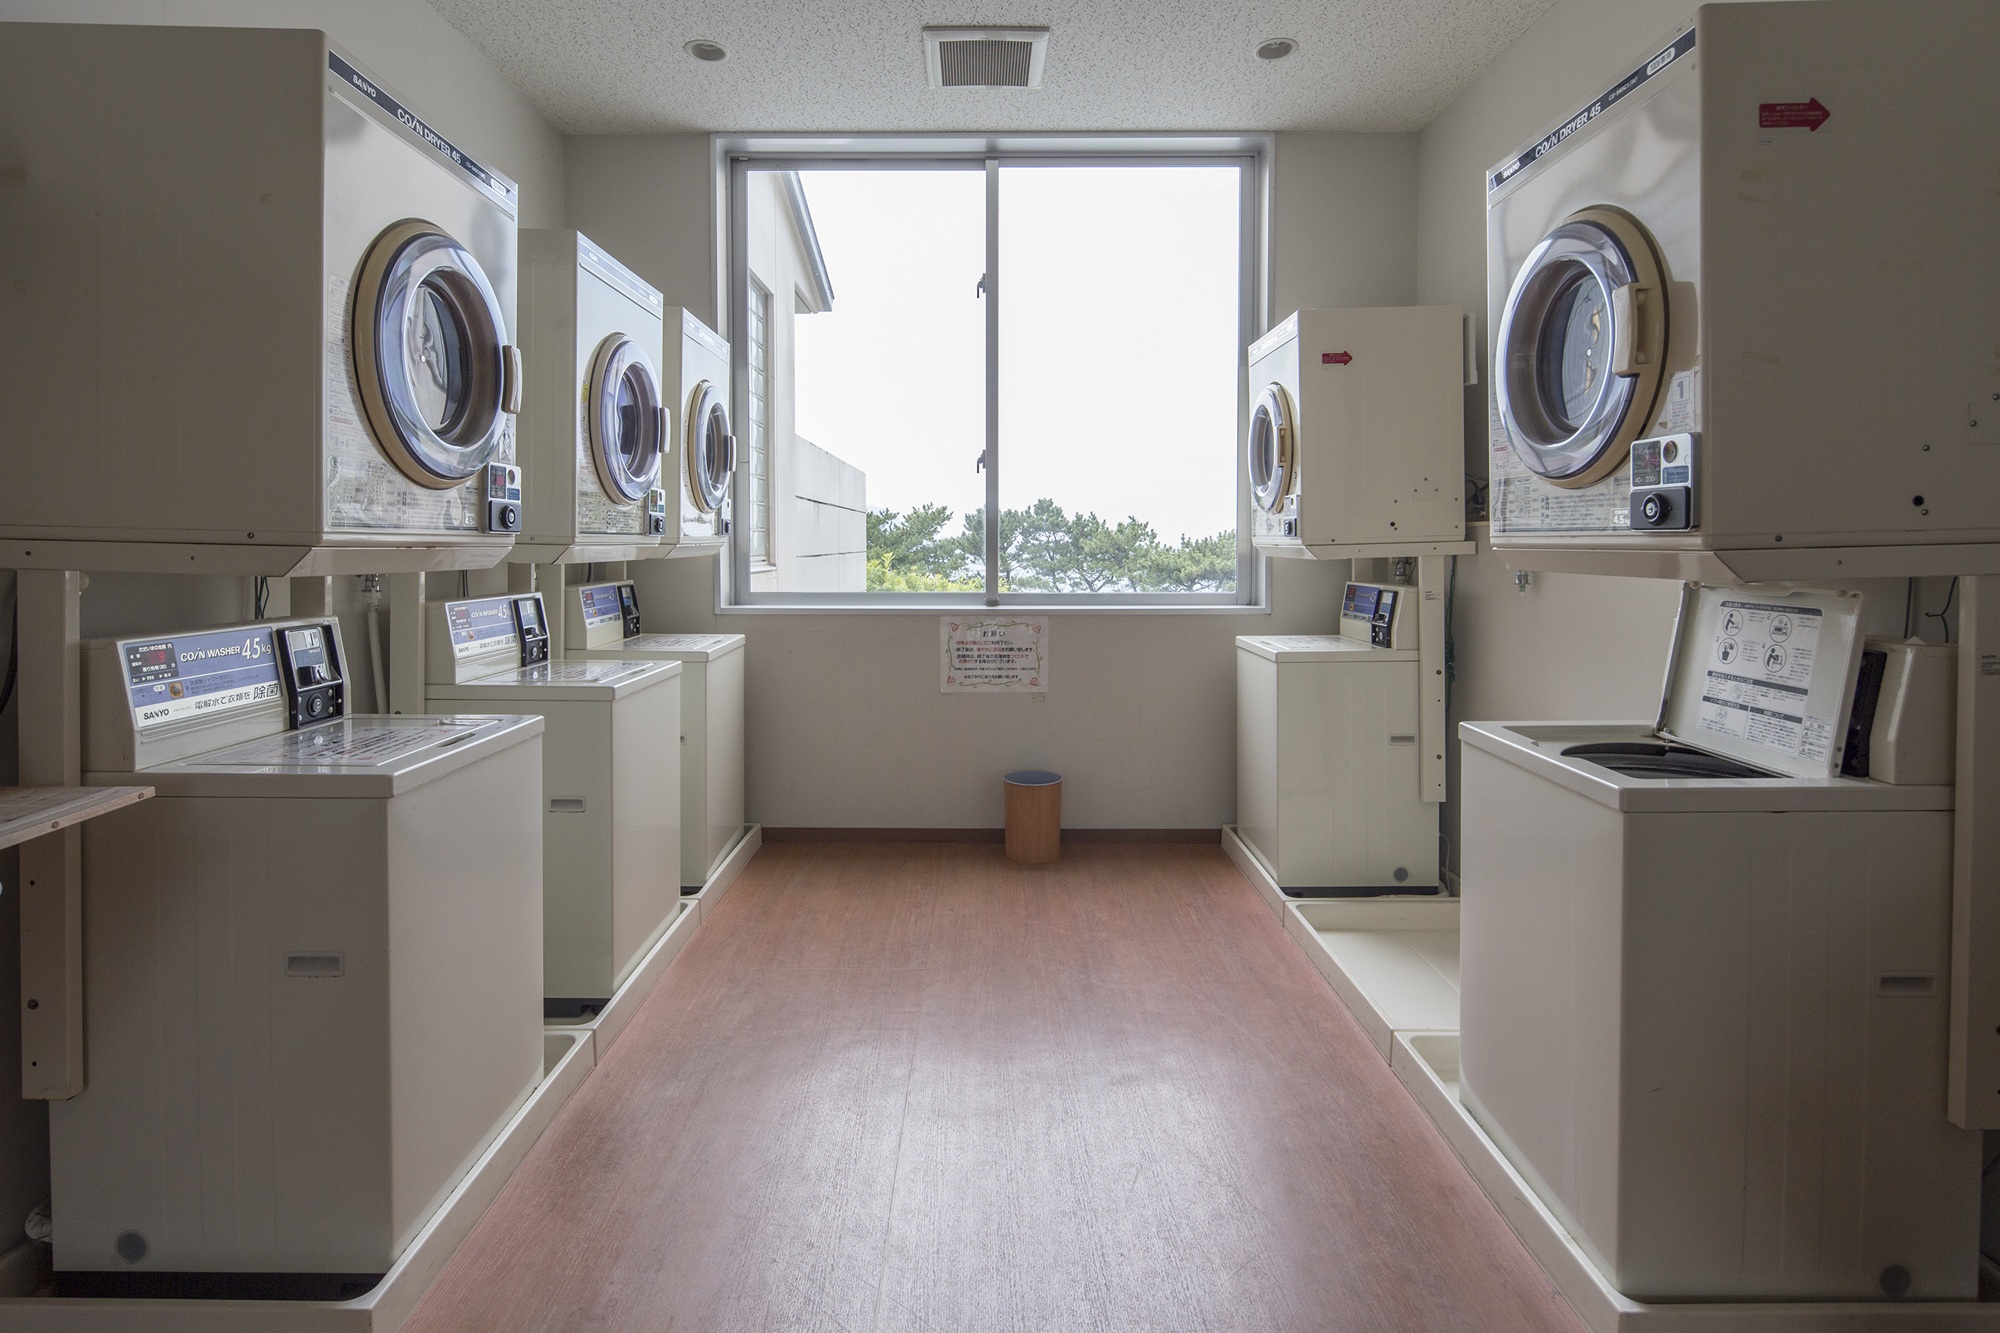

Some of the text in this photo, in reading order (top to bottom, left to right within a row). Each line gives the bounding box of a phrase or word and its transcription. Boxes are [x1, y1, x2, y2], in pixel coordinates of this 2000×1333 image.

[352, 74, 377, 98] SANYO
[424, 128, 451, 157] DRYER
[452, 150, 462, 164] 45
[1559, 111, 1589, 140] DRYER
[1589, 101, 1602, 119] 45
[1677, 380, 1685, 399] 1
[982, 630, 1006, 638] お願い
[207, 646, 241, 658] WASHER
[143, 708, 170, 720] SANYO
